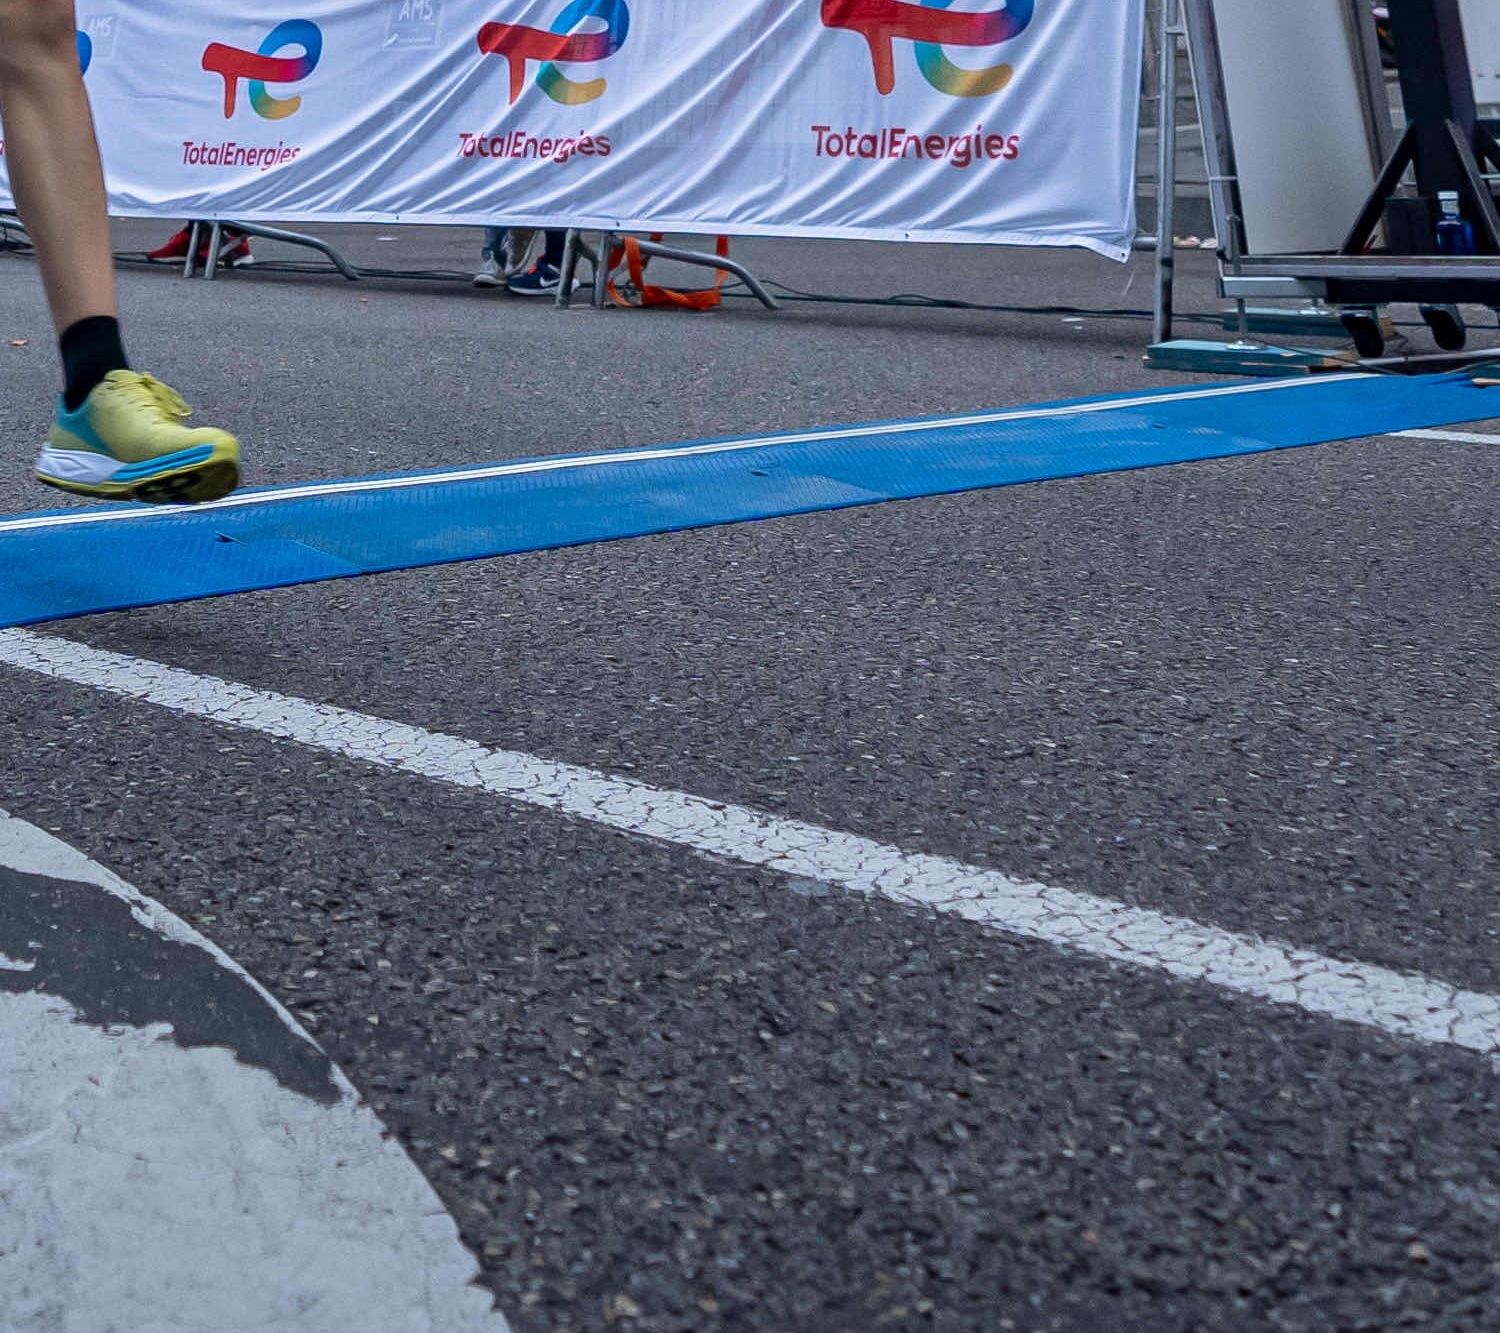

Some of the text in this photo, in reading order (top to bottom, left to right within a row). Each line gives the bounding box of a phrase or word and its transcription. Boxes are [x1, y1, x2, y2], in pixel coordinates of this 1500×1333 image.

[183, 141, 300, 171] TotalEnergies
[458, 130, 611, 164] TotalEnergies
[811, 124, 1020, 167] TotalEnergies
